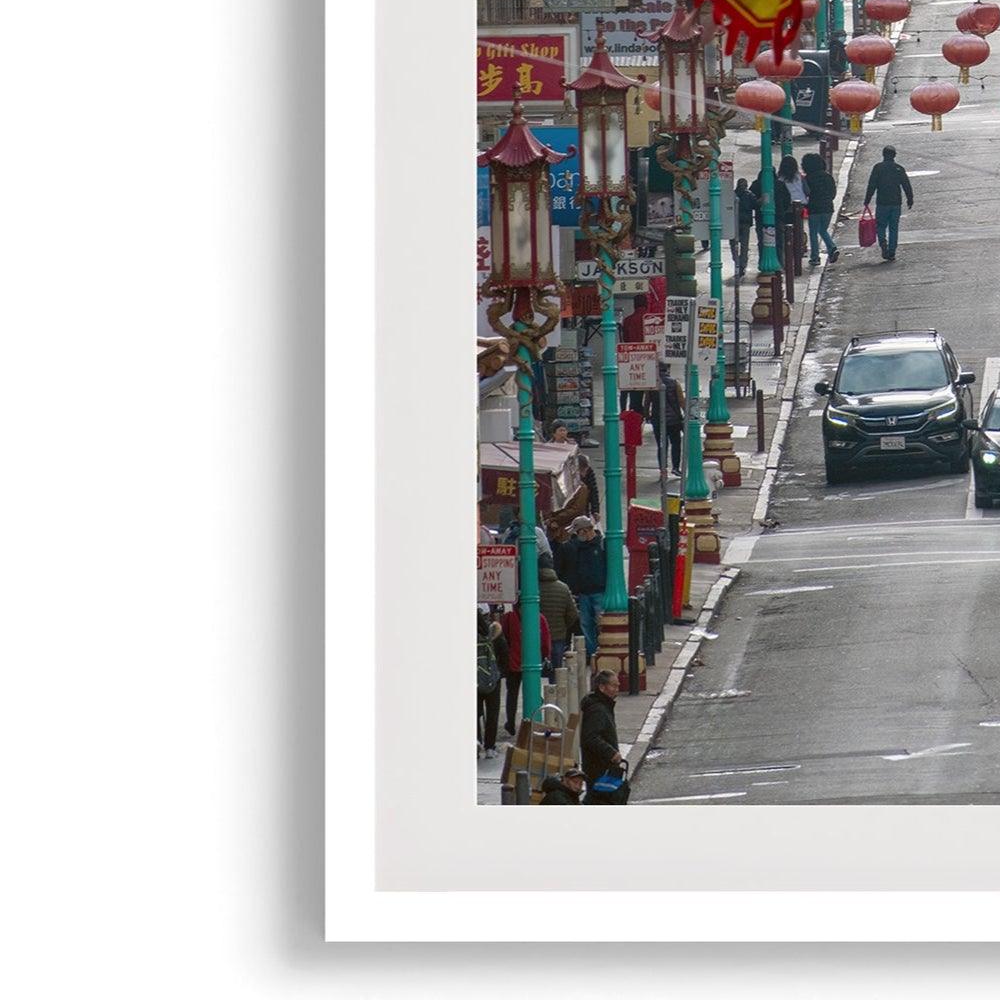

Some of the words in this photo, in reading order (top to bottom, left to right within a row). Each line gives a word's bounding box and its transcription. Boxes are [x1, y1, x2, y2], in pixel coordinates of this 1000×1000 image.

[582, 261, 663, 276] JAKSON
[630, 363, 645, 371] ANY
[629, 372, 646, 380] TIME
[477, 547, 512, 555] W-AWAY
[483, 558, 514, 568] STOPPING
[482, 571, 501, 580] ANY
[481, 583, 503, 592] TIME
